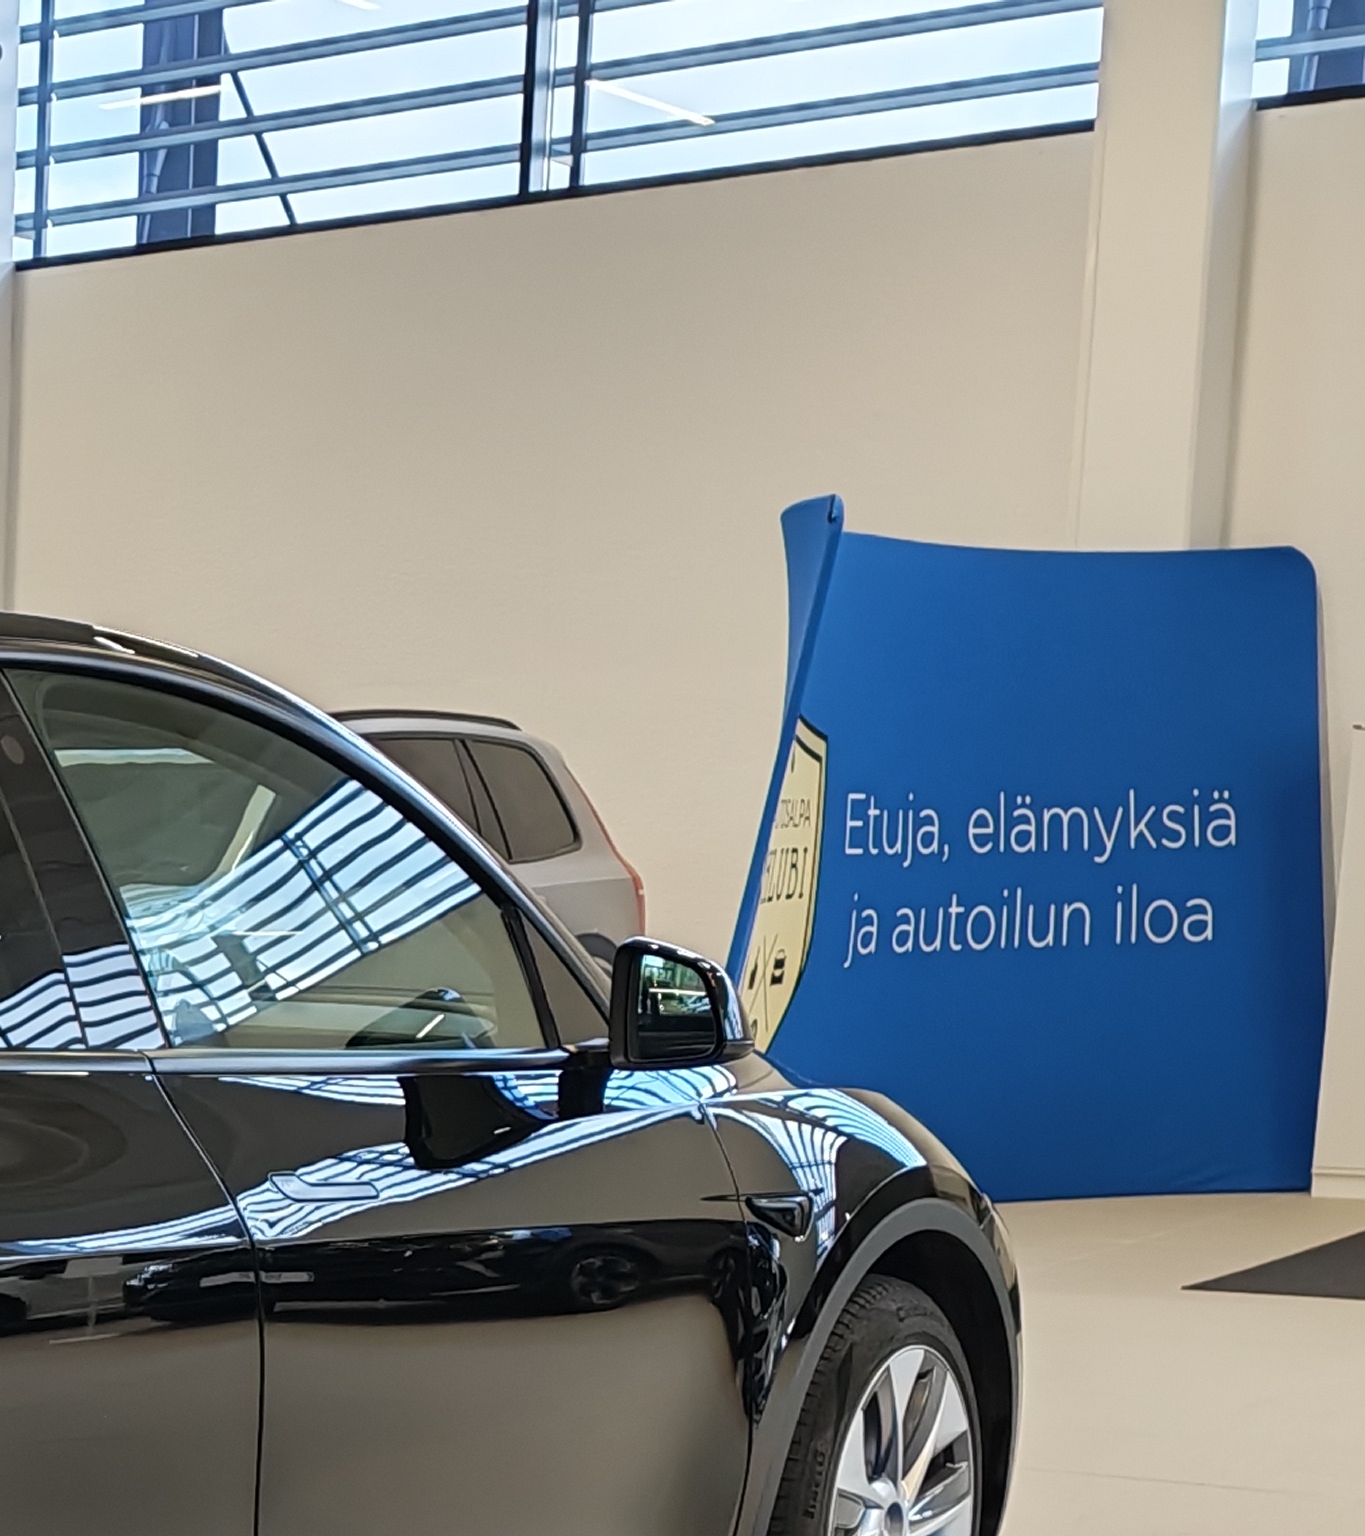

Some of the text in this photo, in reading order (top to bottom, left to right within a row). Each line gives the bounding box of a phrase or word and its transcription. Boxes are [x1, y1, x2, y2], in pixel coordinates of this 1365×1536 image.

[843, 787, 1238, 868] Etuja, elämyksiä
[842, 882, 1215, 969] ja autoilun iloa
